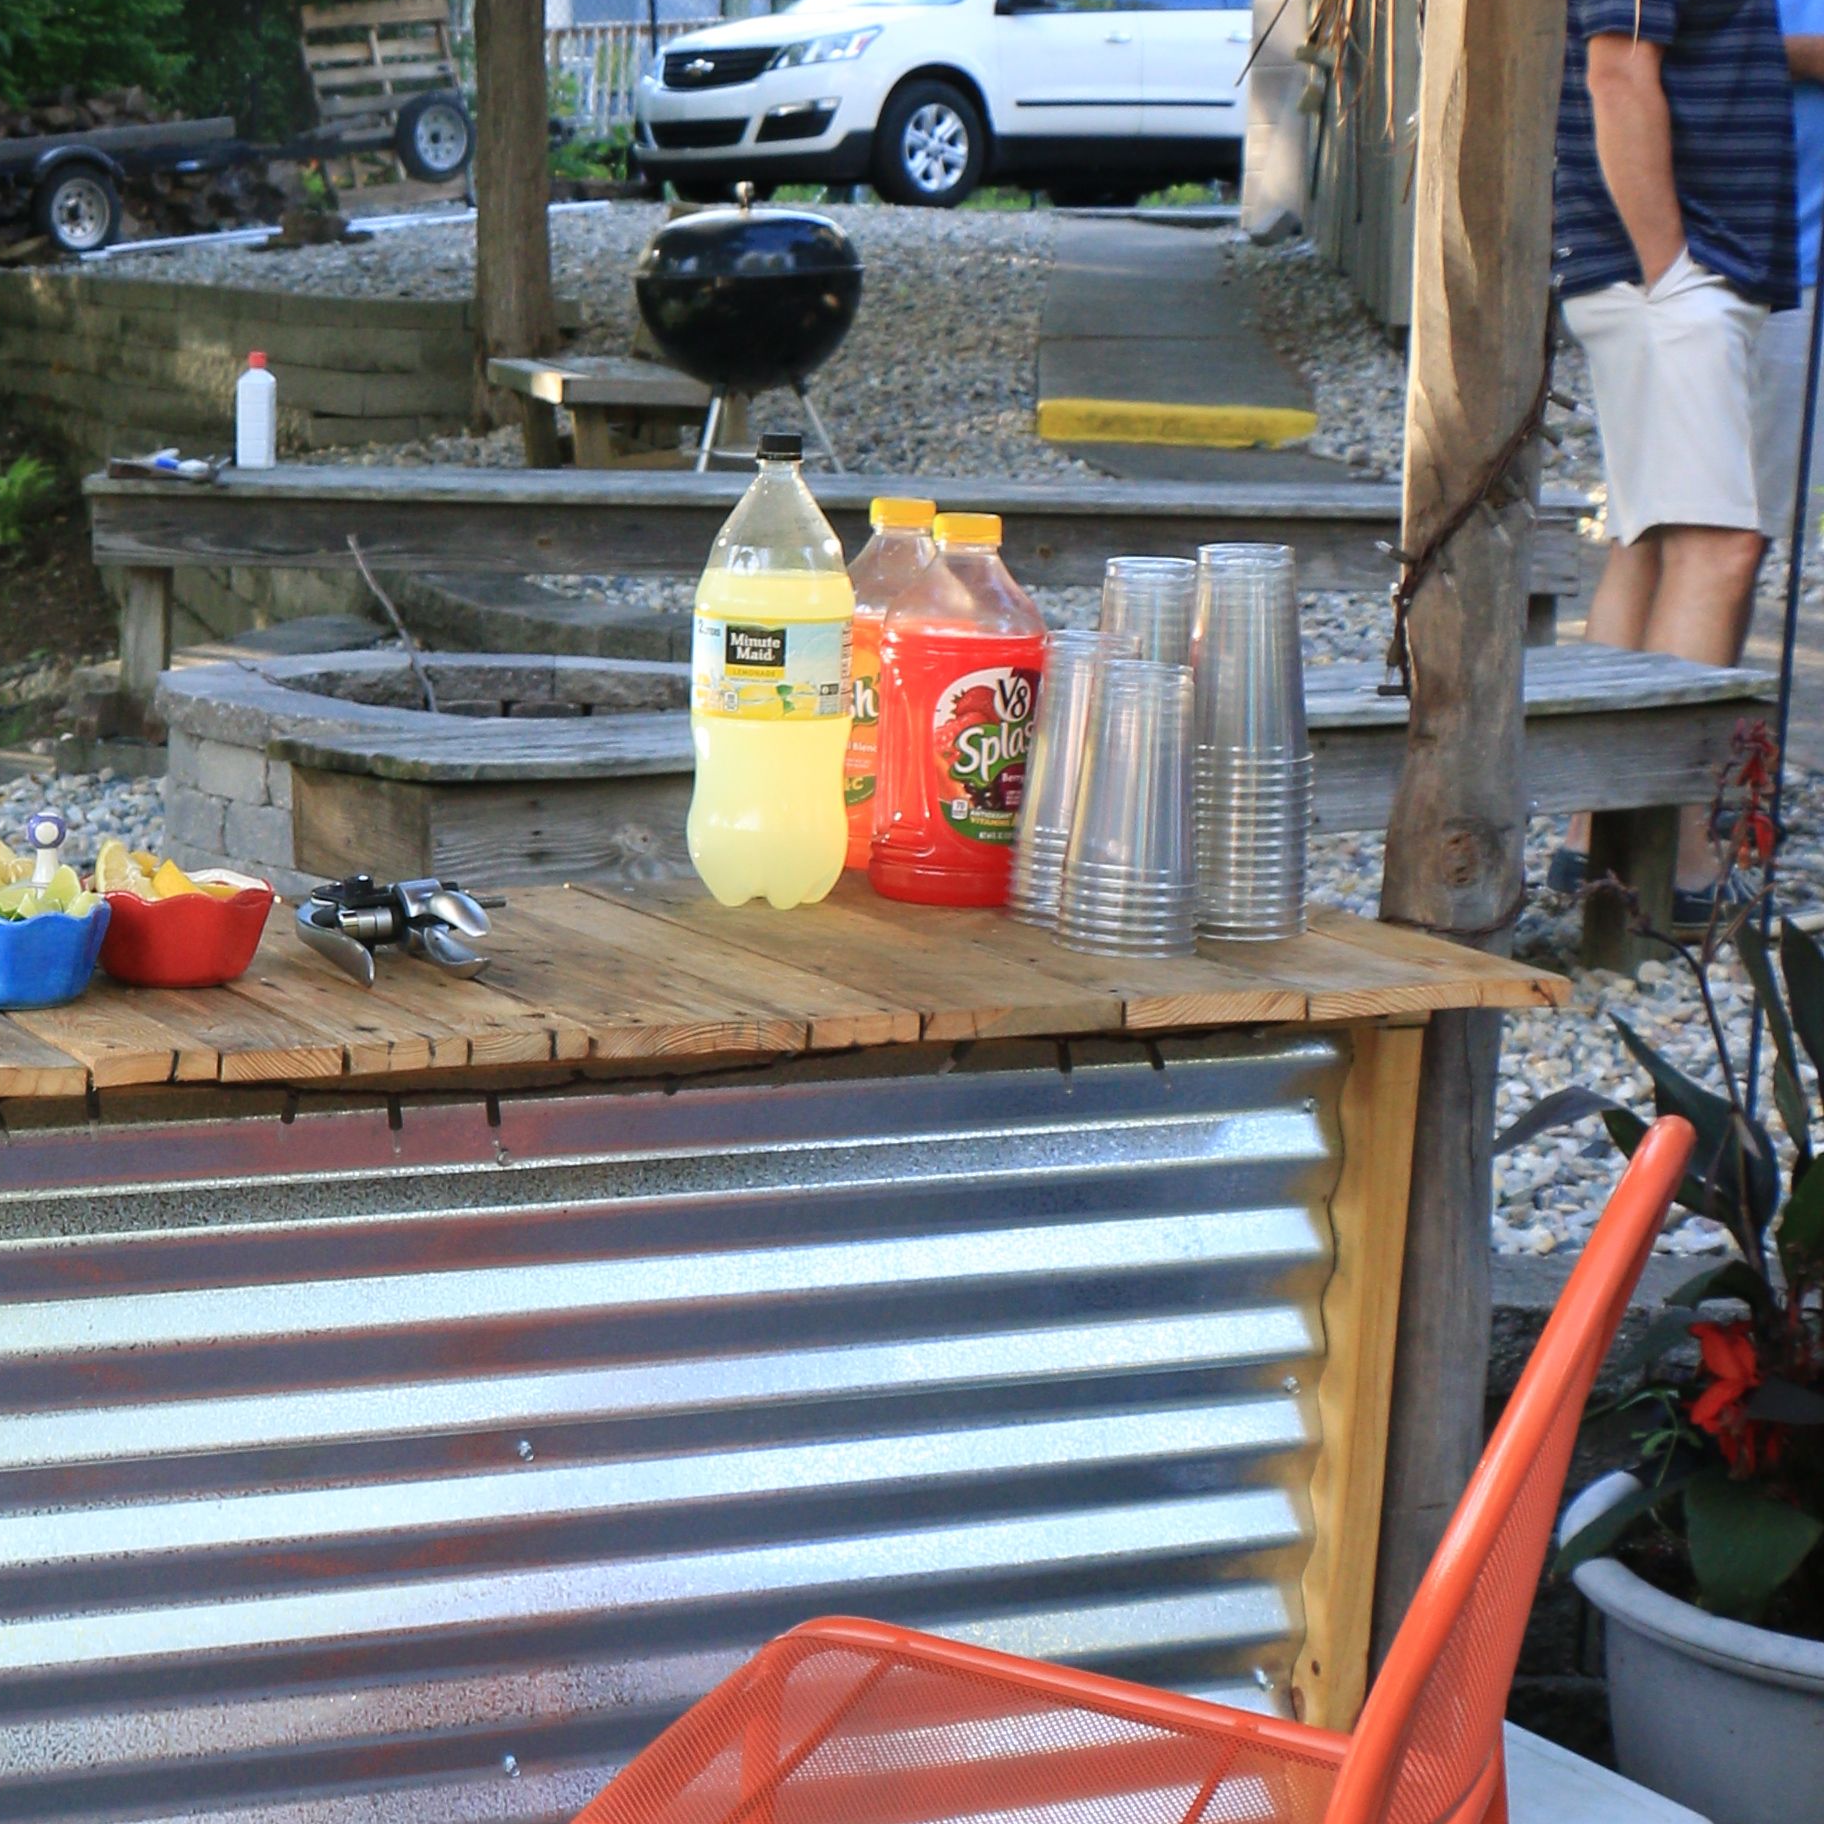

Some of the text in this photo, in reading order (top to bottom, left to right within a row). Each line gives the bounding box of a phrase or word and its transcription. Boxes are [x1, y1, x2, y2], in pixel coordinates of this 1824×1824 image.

[730, 632, 782, 649] Minute
[735, 647, 776, 662] Maid
[996, 676, 1029, 719] V8
